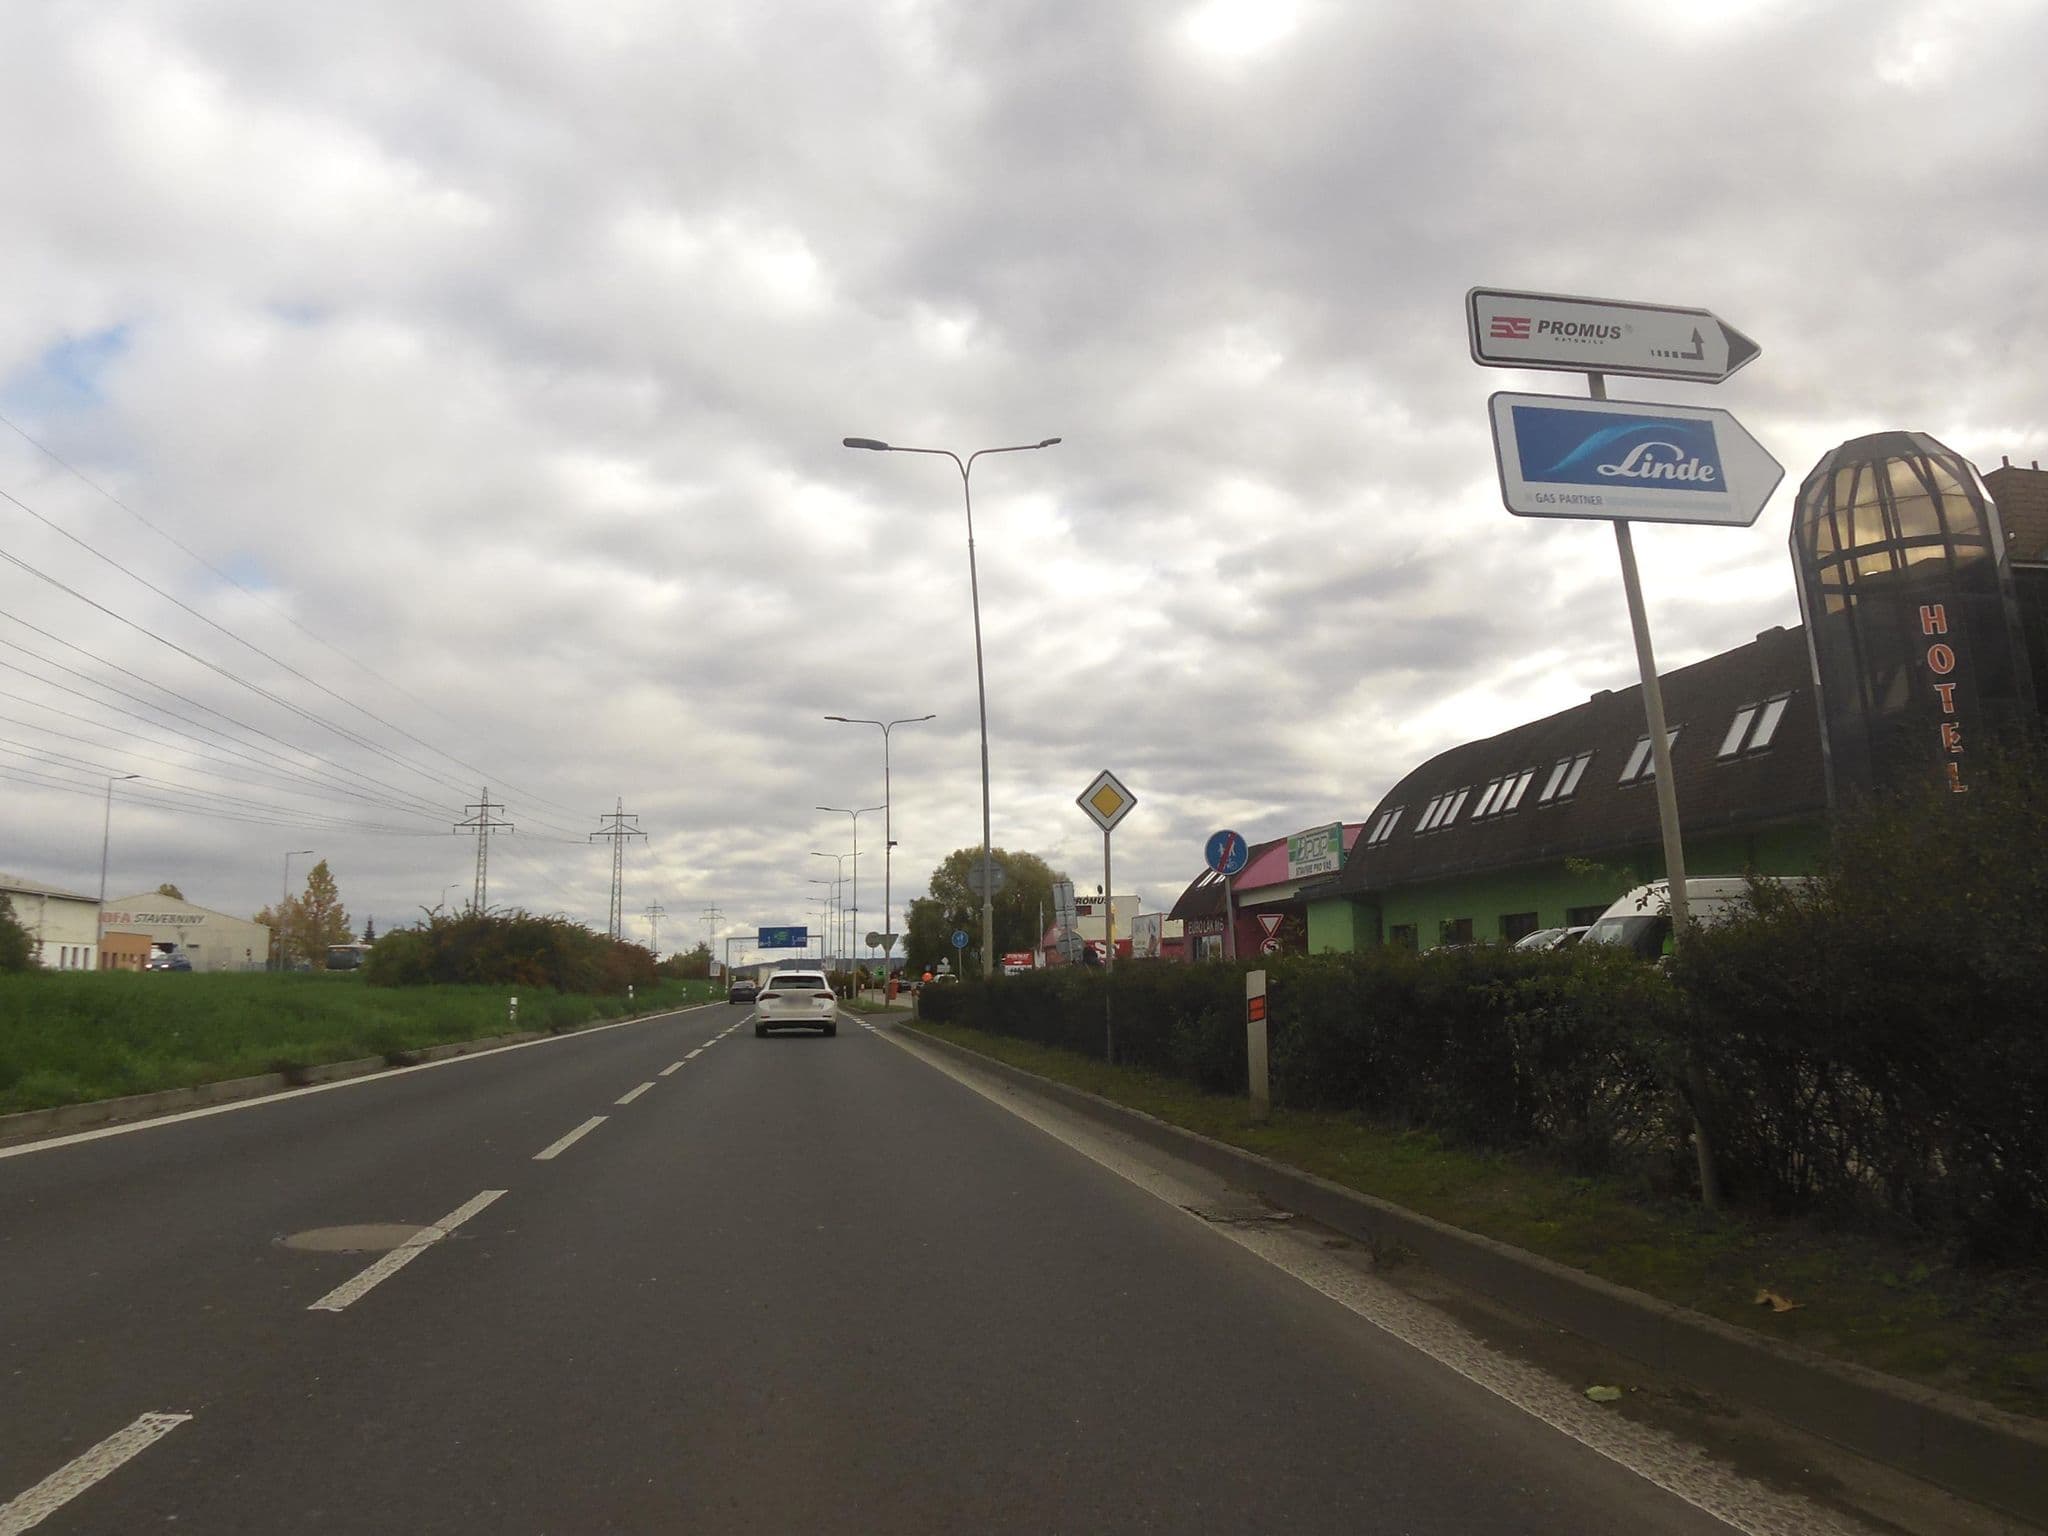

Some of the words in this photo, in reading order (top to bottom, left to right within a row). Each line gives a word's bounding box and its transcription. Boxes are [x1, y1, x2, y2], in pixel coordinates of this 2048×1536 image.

[1537, 320, 1622, 339] PROMUS
[1596, 441, 1716, 482] Linde
[1535, 492, 1556, 504] GAS
[1559, 493, 1603, 505] PARTNER
[1919, 604, 1969, 793] HOTEL
[133, 912, 206, 925] STAVEBNINY
